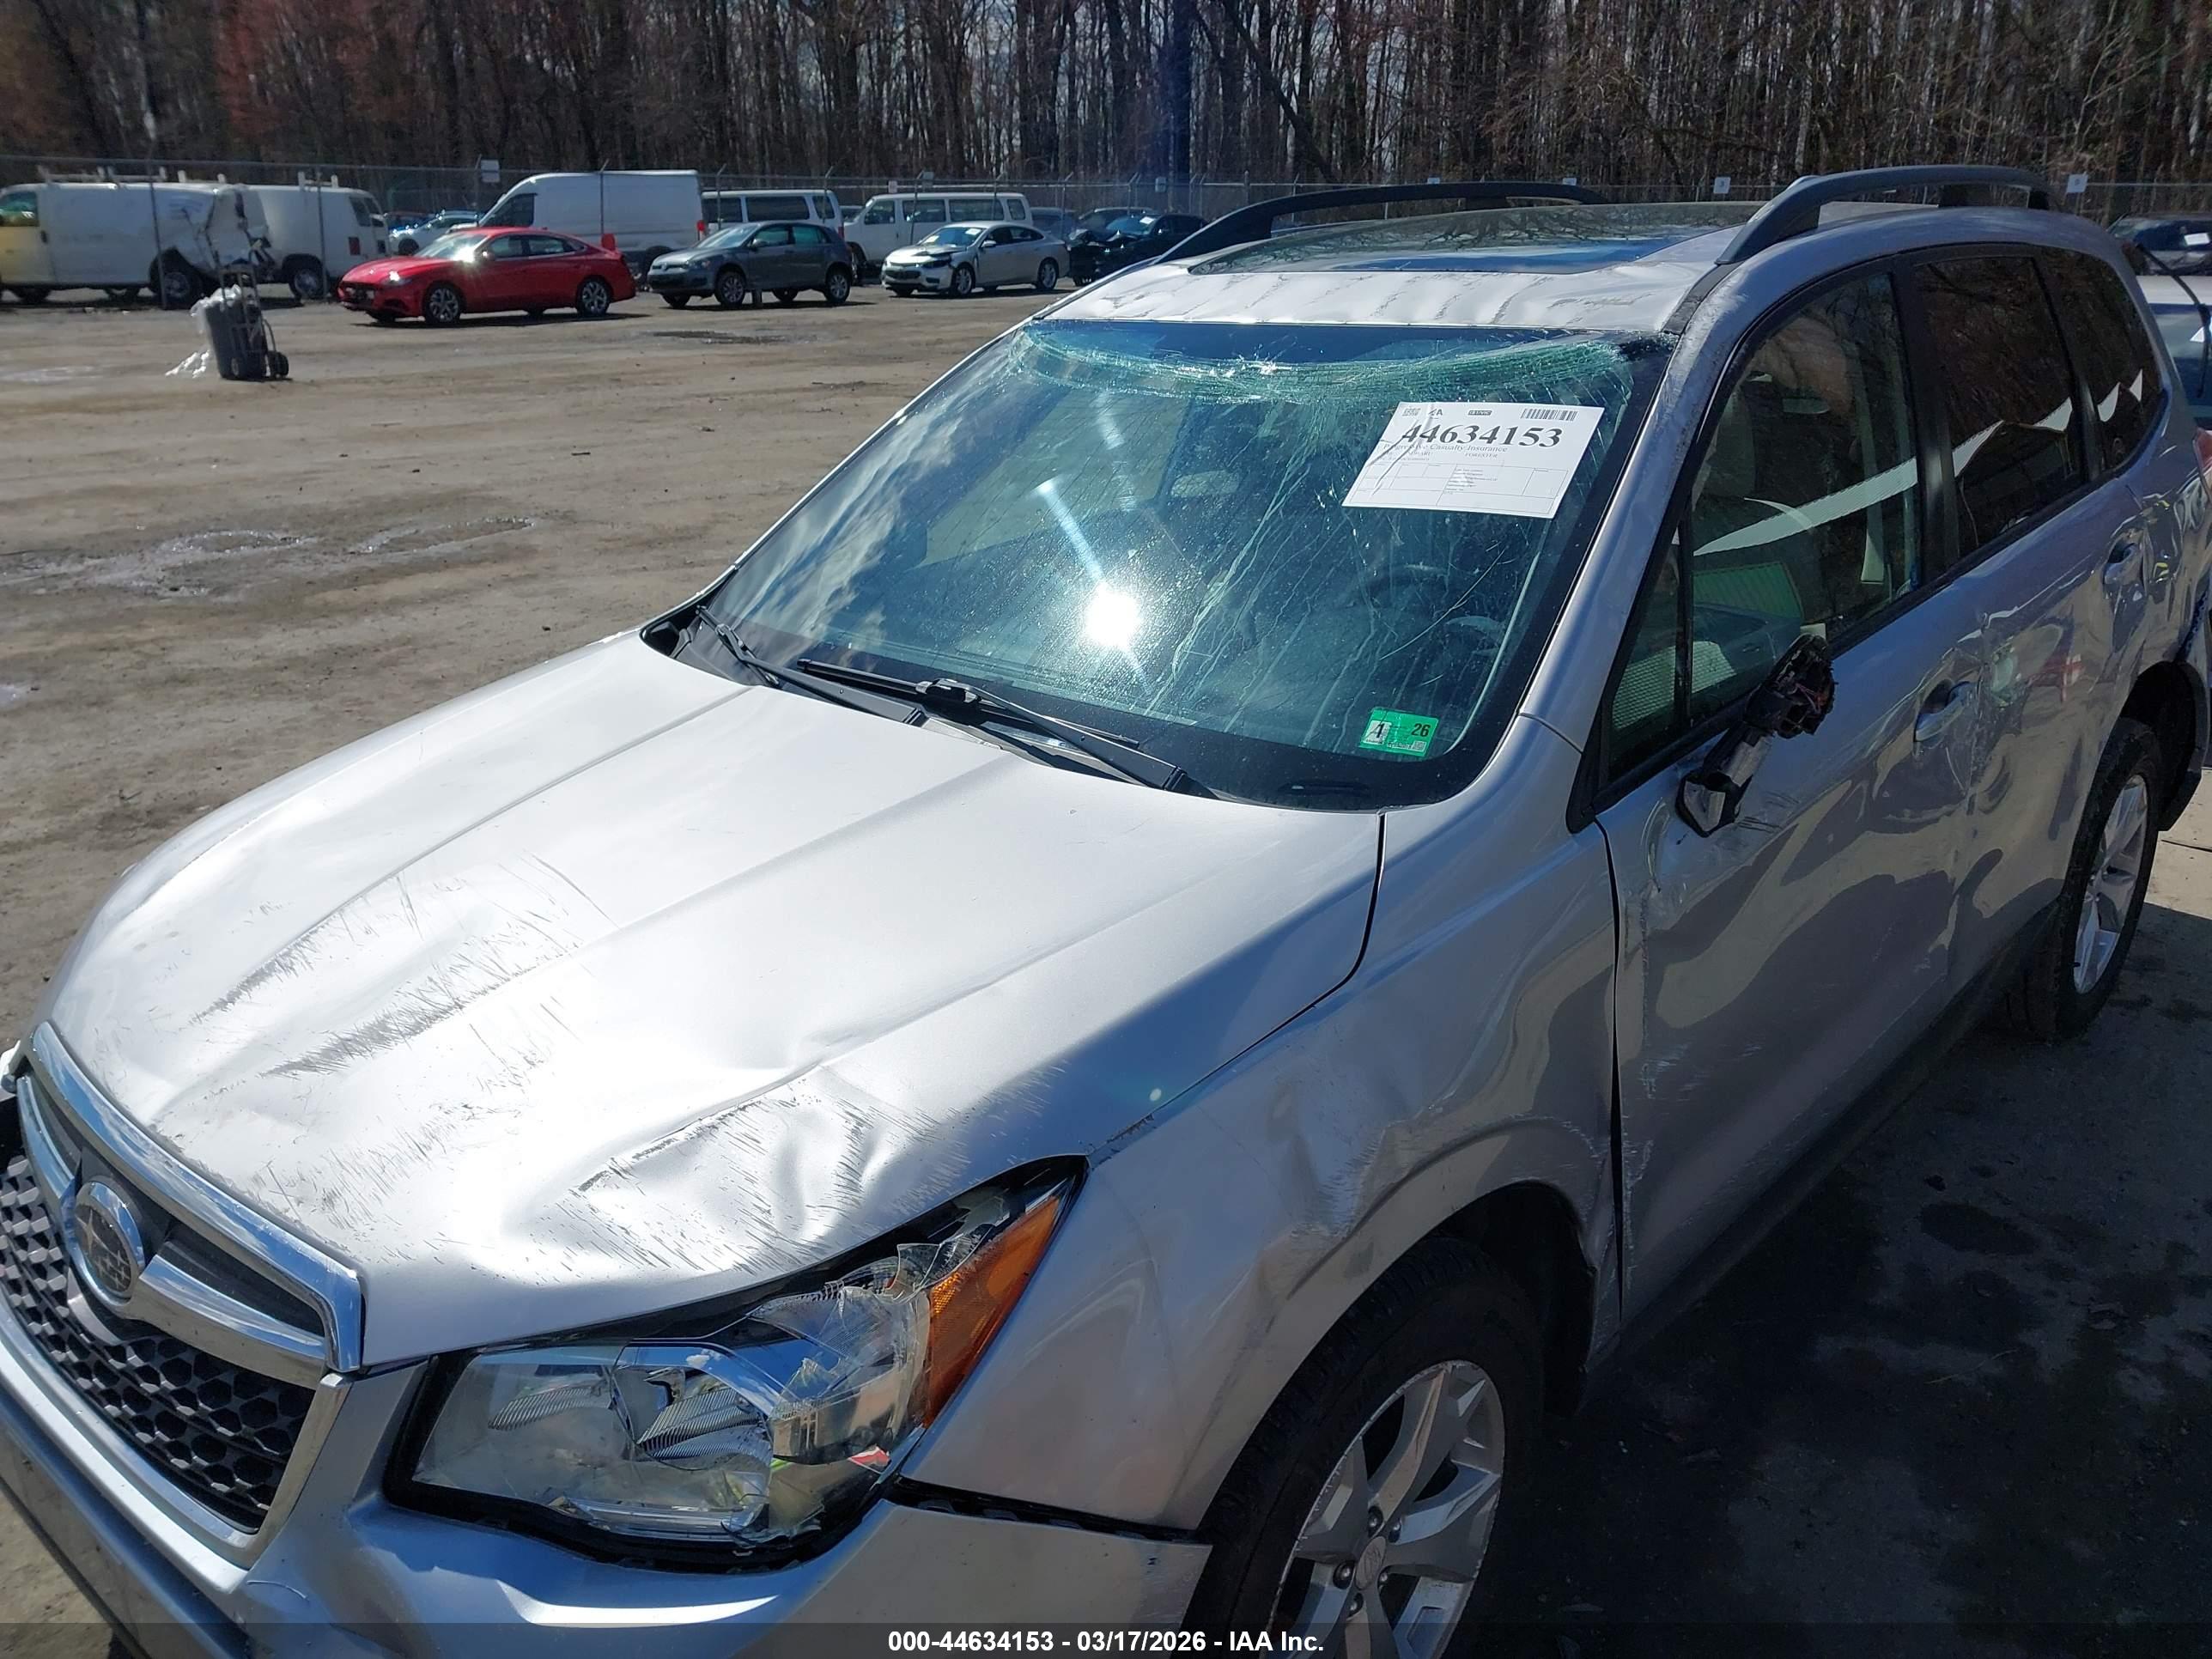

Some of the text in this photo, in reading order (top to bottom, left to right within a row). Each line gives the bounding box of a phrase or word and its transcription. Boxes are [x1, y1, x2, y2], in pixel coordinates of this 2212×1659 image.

[1402, 424, 1562, 447] 44634153
[1383, 443, 1508, 453] Pgreive Casualty Insurance
[1411, 722, 1431, 737] 26
